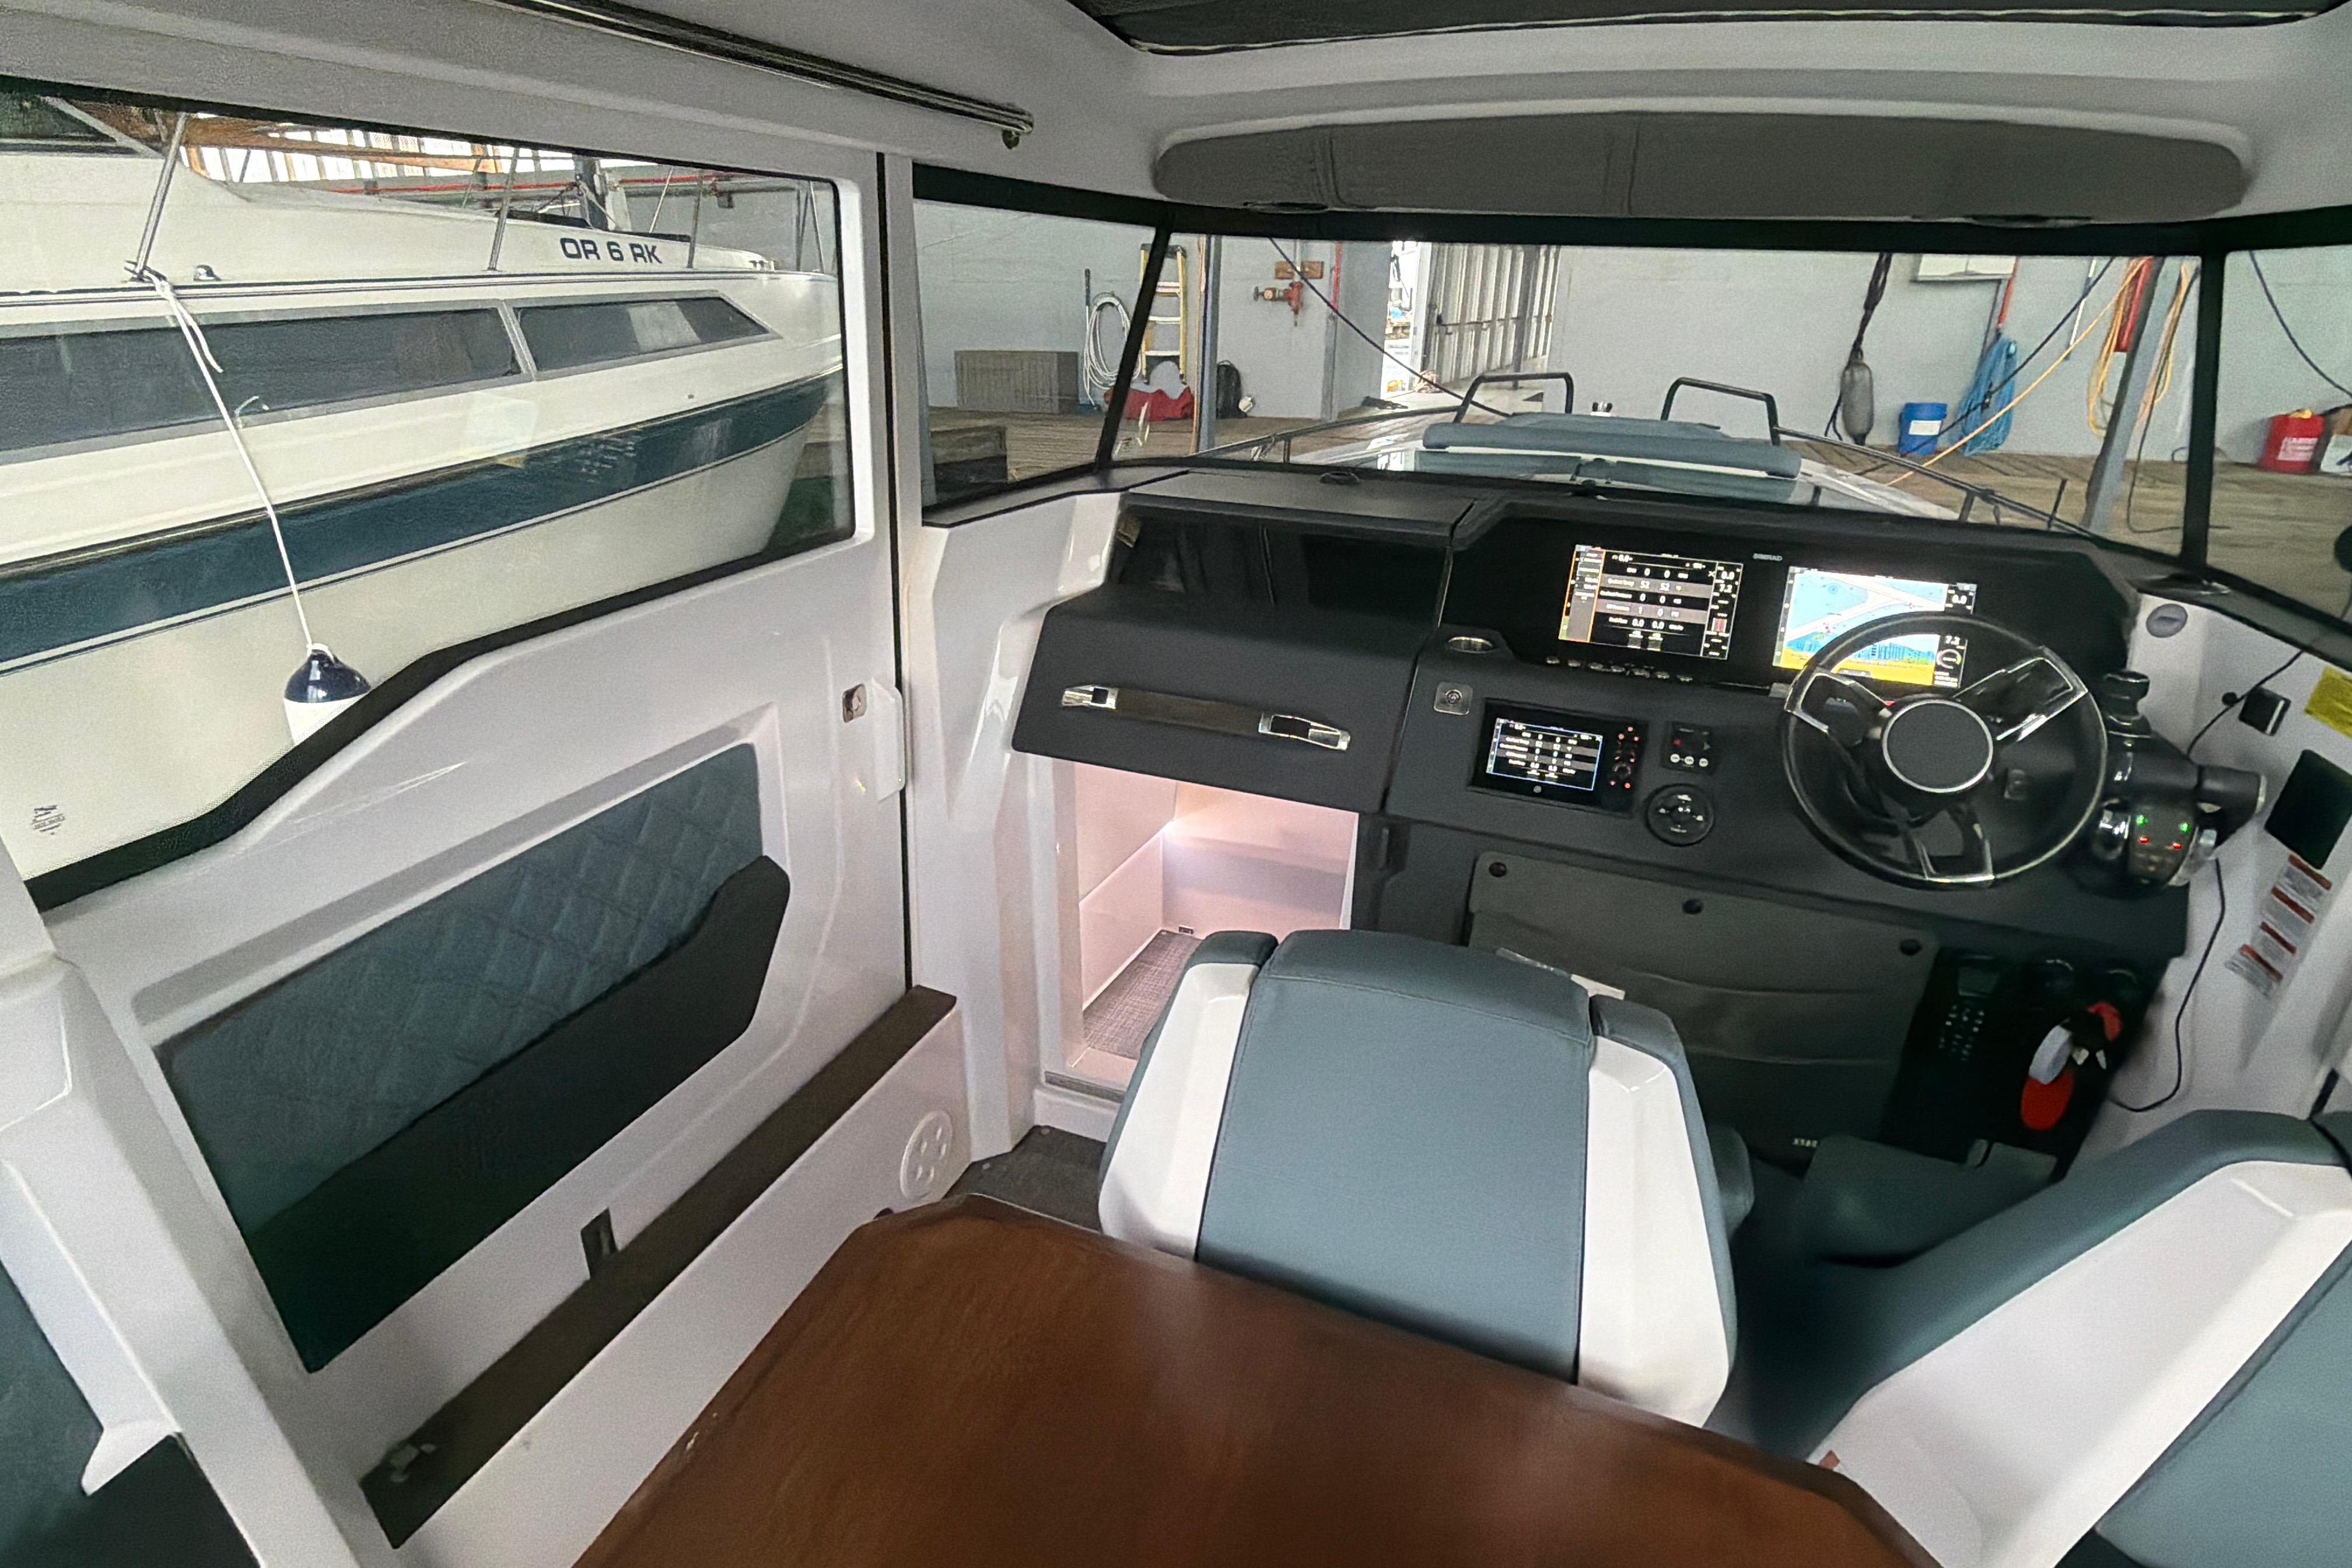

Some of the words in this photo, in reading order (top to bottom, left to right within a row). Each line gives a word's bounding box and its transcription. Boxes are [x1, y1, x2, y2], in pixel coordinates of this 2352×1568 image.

[560, 237, 601, 260] OR
[607, 241, 624, 261] 6
[629, 243, 663, 264] RK
